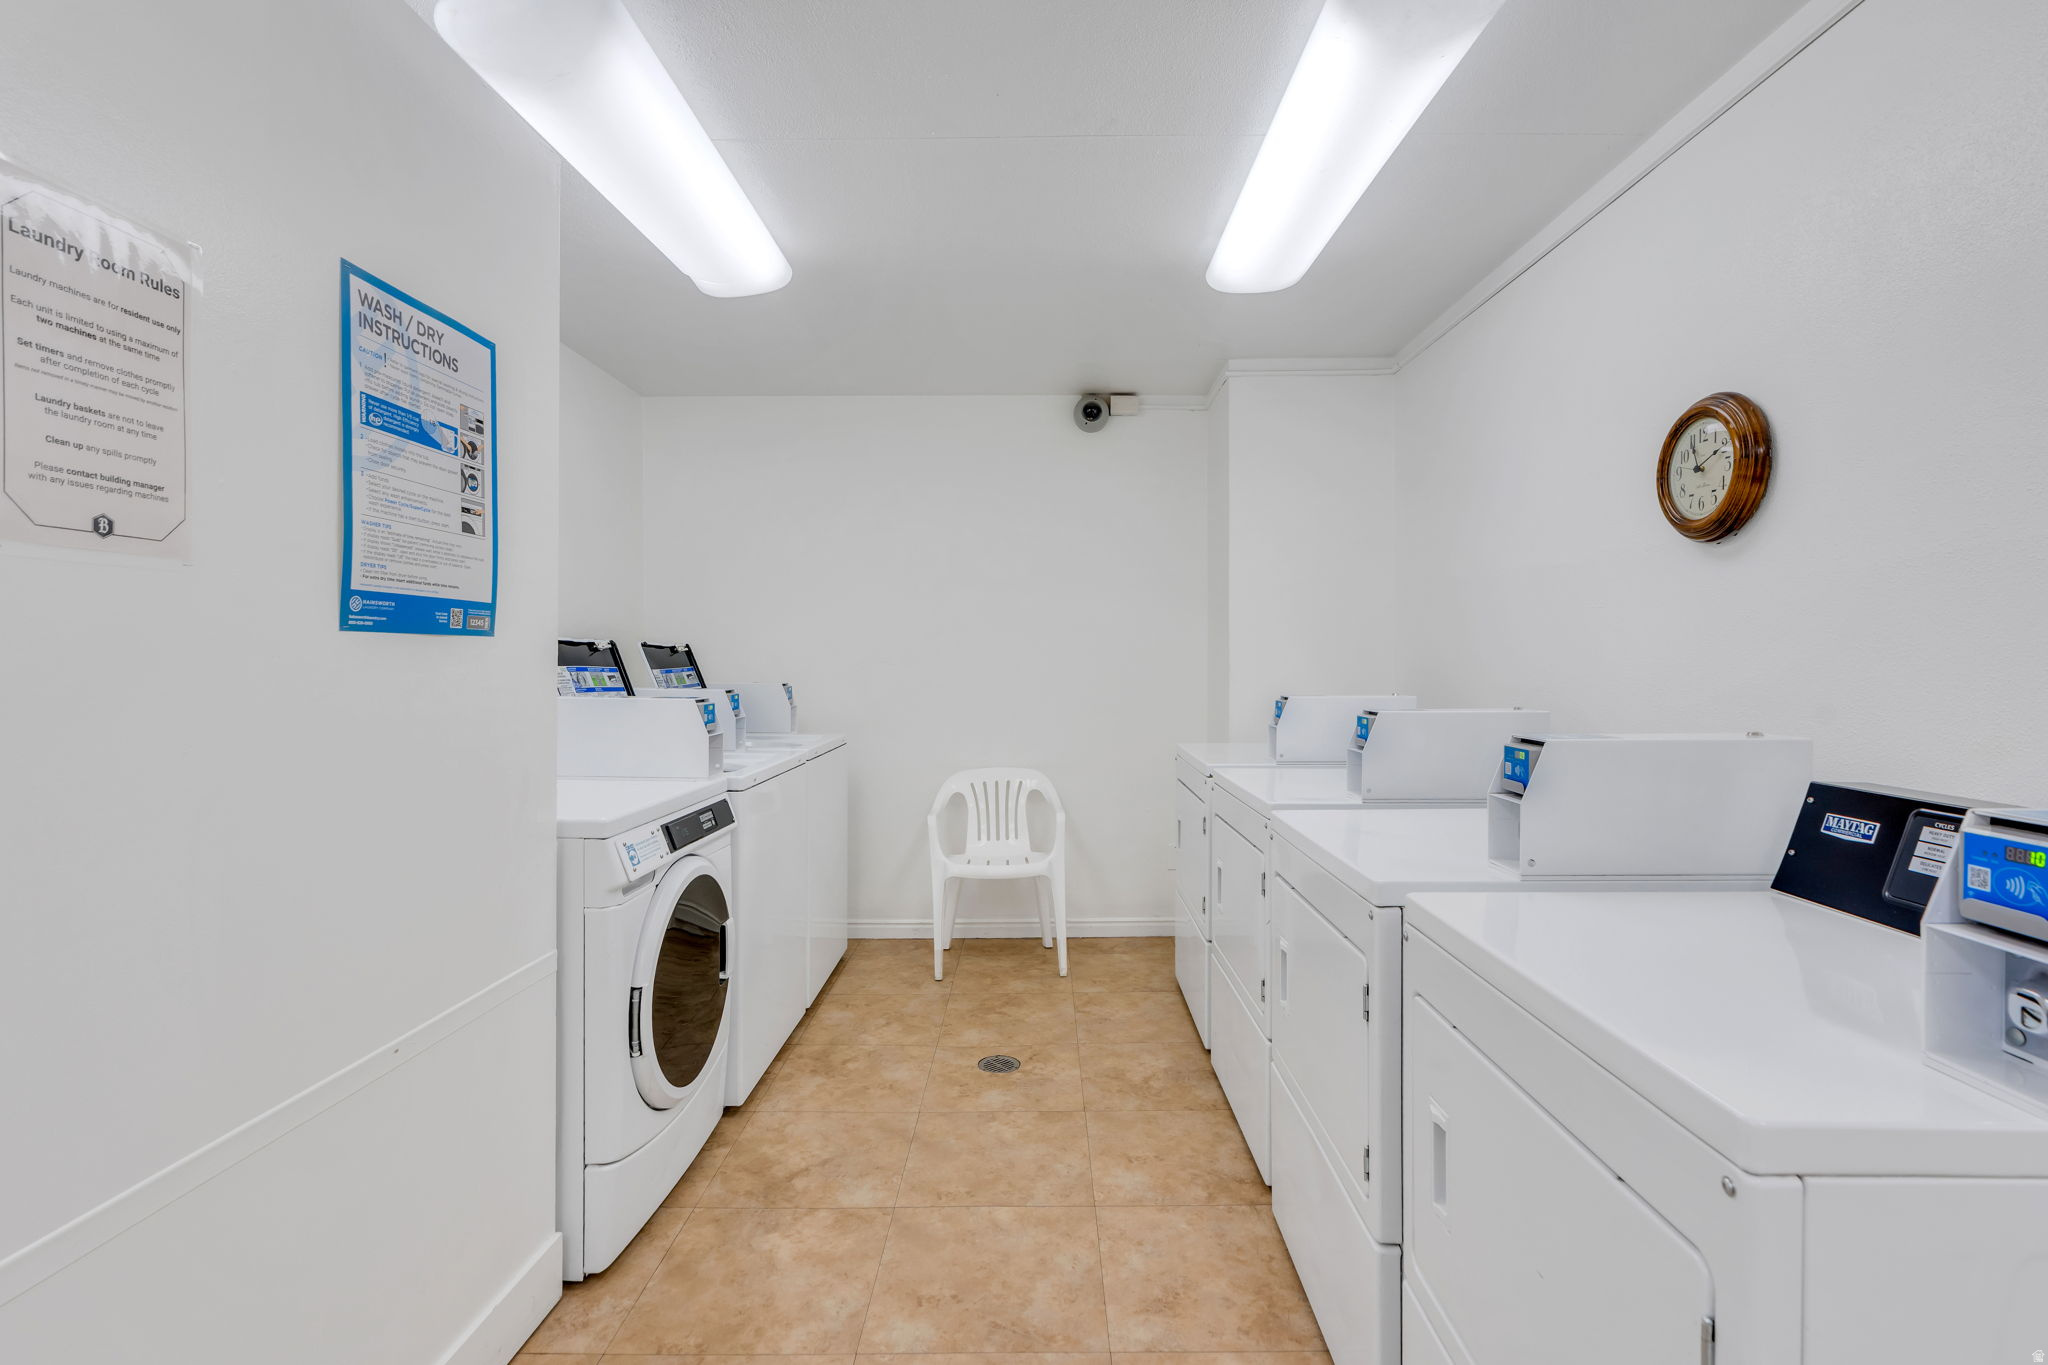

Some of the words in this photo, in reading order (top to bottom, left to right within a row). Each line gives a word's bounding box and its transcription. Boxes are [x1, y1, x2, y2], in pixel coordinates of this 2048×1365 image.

[8, 218, 84, 262] Laundry
[140, 272, 180, 299] Rules
[9, 265, 47, 286] Laundry
[49, 281, 91, 301] machines
[93, 297, 106, 306] are
[108, 301, 118, 311] for
[121, 307, 150, 323] resident
[152, 320, 164, 328] use
[166, 325, 181, 335] only
[10, 294, 34, 308] Each
[36, 305, 53, 315] unit
[66, 313, 94, 329] limited
[96, 324, 104, 332] to
[106, 329, 127, 342] using
[135, 338, 170, 355] maximum
[358, 289, 402, 326] WASH
[405, 315, 413, 332] /
[417, 320, 444, 346] DRY
[36, 315, 53, 326] two
[56, 322, 97, 340] machines
[99, 336, 107, 344] at
[109, 339, 121, 348] the
[123, 344, 143, 356] same
[144, 351, 160, 362] time
[359, 311, 458, 373] INSTRUCTIONS
[17, 337, 33, 348] Set
[35, 343, 64, 358] timers
[67, 354, 83, 363] and
[84, 358, 114, 372] remove
[116, 368, 143, 382] clothes
[145, 377, 175, 392] promptly
[40, 356, 61, 367] after
[63, 363, 109, 381] completion
[121, 380, 139, 390] each
[141, 386, 159, 396] cycle
[35, 393, 71, 410] Laundry
[73, 402, 106, 417] baskets
[108, 413, 120, 421] are
[122, 416, 134, 425] not
[136, 419, 144, 427] to
[145, 421, 164, 432] leave
[44, 407, 59, 416] the
[61, 410, 92, 426] laundry
[94, 420, 115, 430] room
[126, 428, 139, 437] any
[141, 431, 157, 440] time
[45, 435, 70, 447] Clean
[73, 442, 84, 451] up
[86, 445, 100, 455] any
[102, 448, 122, 458] spills
[124, 453, 157, 467] promptly
[1680, 449, 1690, 465] 10
[28, 473, 47, 481] with
[49, 477, 65, 486] any
[67, 478, 94, 490] issues
[96, 485, 133, 498] regarding
[135, 492, 169, 503] machines
[34, 461, 64, 474] Please
[66, 469, 98, 479] contact
[100, 473, 131, 487] building
[133, 481, 165, 492] manager
[1676, 466, 1683, 480] 9
[1679, 483, 1686, 498] 8
[1688, 493, 1695, 509] 7
[1698, 496, 1705, 511] 6
[1710, 489, 1718, 505] 5
[1825, 815, 1875, 836] MAYTAG
[1934, 822, 1955, 831] CYCLES
